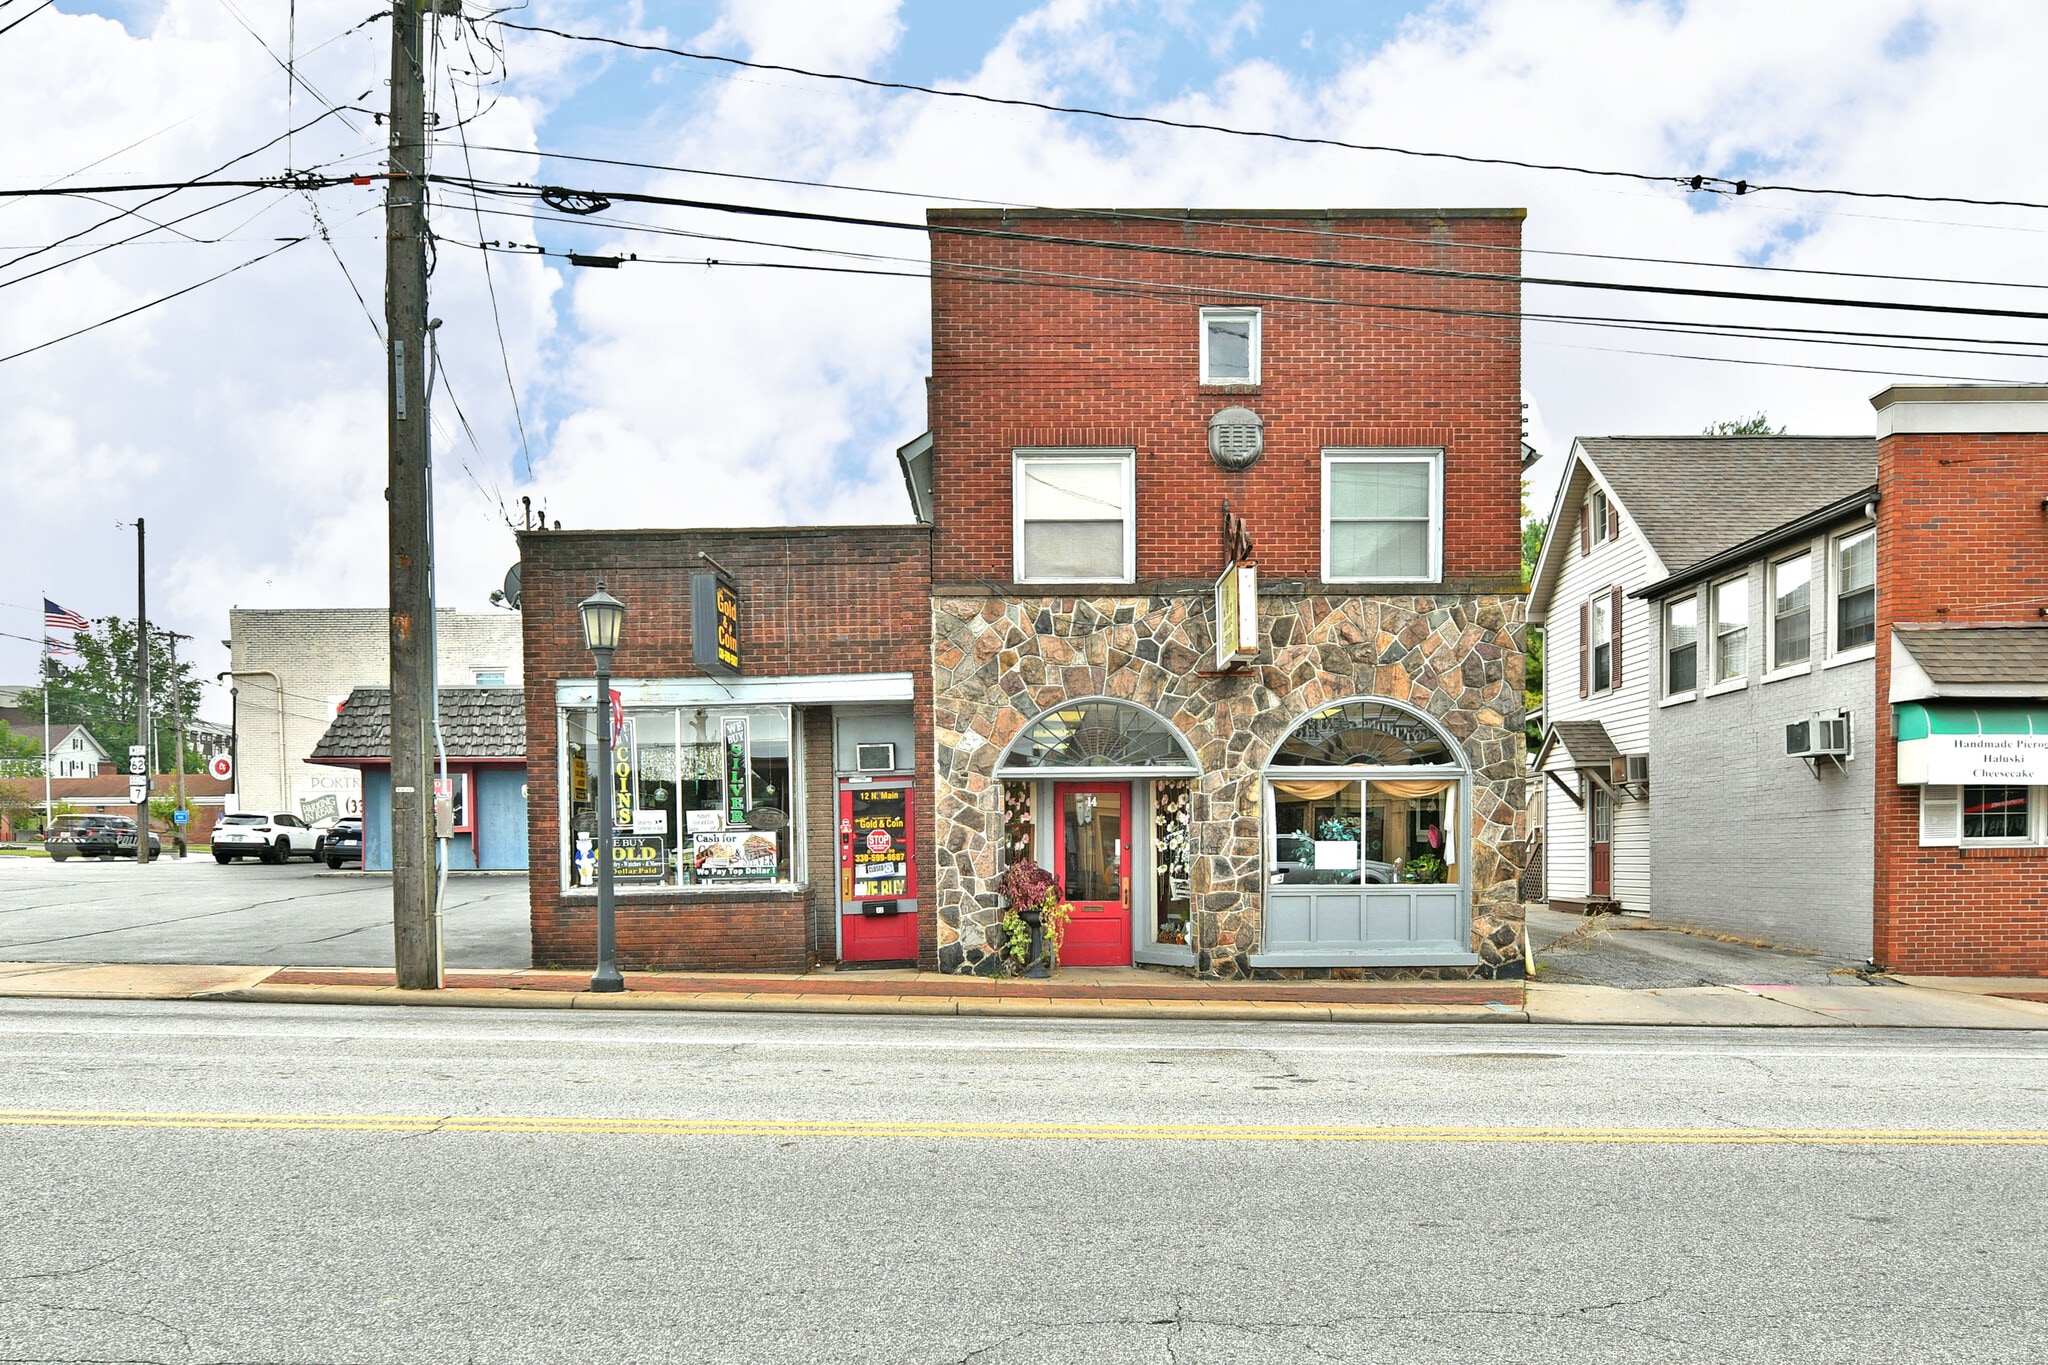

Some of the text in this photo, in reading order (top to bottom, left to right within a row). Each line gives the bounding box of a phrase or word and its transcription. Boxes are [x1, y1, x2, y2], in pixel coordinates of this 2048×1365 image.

[717, 592, 737, 621] Gold
[718, 625, 737, 653] Coin
[726, 721, 744, 734] WE
[727, 731, 744, 744] BUY
[1954, 739, 2013, 749] Handmade
[1983, 754, 2025, 763] Haluski
[131, 760, 144, 770] 62
[1972, 768, 2035, 778] Cheesecake
[616, 746, 631, 824] COINS
[730, 744, 746, 823] SILVER
[135, 789, 141, 799] 7
[860, 792, 869, 800] 12
[881, 791, 899, 800] Main
[302, 796, 336, 814] PARKING
[1086, 796, 1097, 807] 14
[305, 805, 335, 822] IN REAR
[860, 819, 904, 829] Gold & Coin
[117, 835, 138, 846] POLI
[622, 839, 646, 847] BUY
[696, 834, 737, 843] Cash for
[869, 835, 889, 845] STOP
[594, 847, 657, 861] OLD
[696, 868, 709, 876] We
[711, 868, 727, 877] Pay
[728, 868, 744, 876] Top
[745, 867, 771, 875] Dollar
[868, 864, 885, 873] CLOSED
